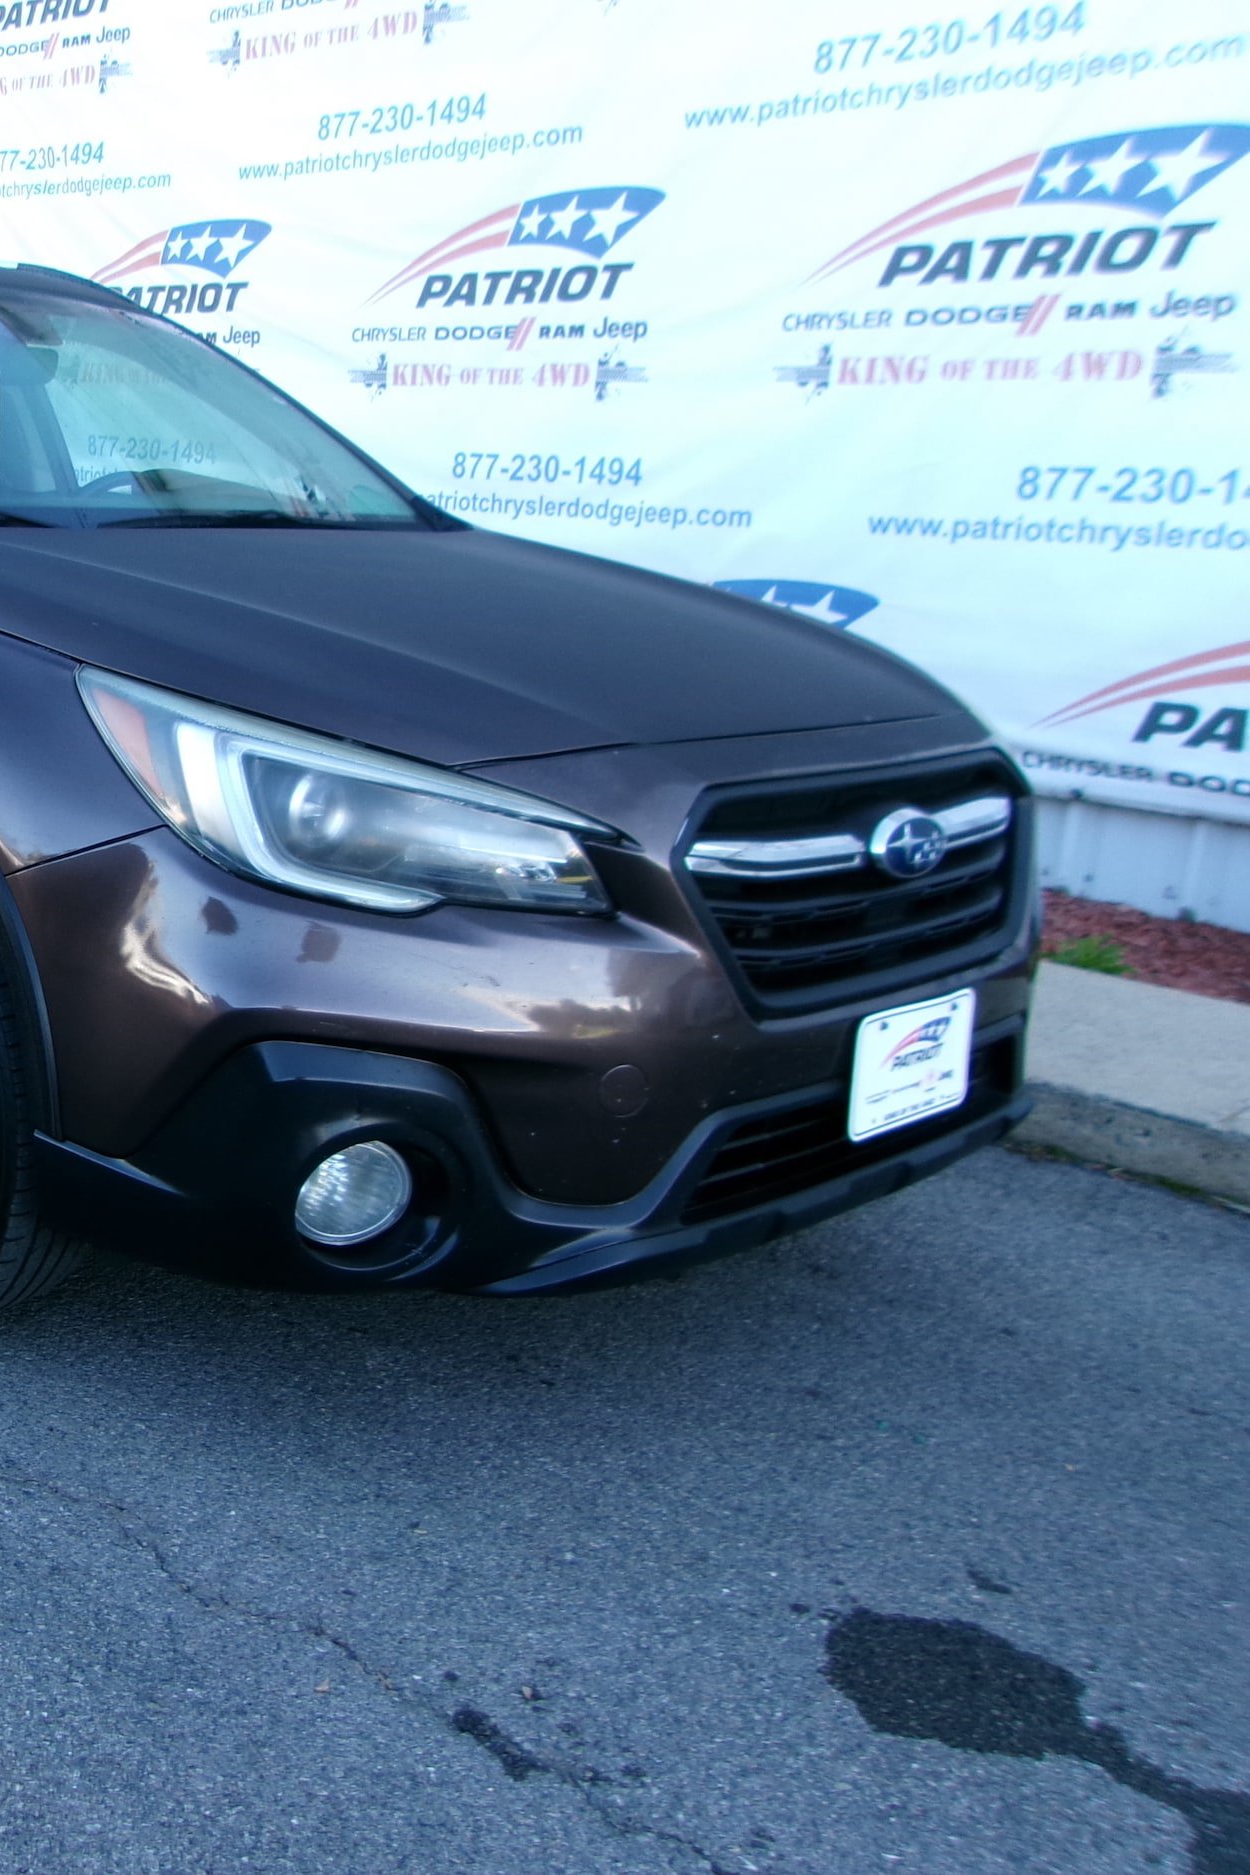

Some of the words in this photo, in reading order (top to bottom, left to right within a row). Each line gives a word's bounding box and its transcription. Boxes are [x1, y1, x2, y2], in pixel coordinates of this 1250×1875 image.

[62, 33, 92, 48] RAM
[96, 25, 132, 44] Jeep
[244, 31, 298, 61] KING
[303, 32, 324, 48] OF
[326, 24, 360, 45] THE
[367, 10, 419, 40] 4WD
[813, 0, 1087, 76] 877-230-1494
[684, 34, 1246, 131] www.patriotchryslerdodgejeep.com
[317, 92, 488, 142] 877-230-1494
[238, 124, 584, 182] www.patriotchryslerdodgejeep.com
[876, 219, 1218, 289] PATRIOT
[109, 280, 249, 316] ATRIOT
[415, 260, 636, 310] PATRIOT
[351, 325, 427, 343] CHRYSLER
[434, 323, 518, 341] DODGE
[538, 323, 586, 340] RAM
[592, 315, 648, 344] Jeep
[782, 309, 892, 334] CHRYSLER
[904, 302, 1030, 328] DODGE
[1064, 300, 1139, 322] RAM
[1150, 288, 1238, 323] Jeep
[222, 325, 261, 349] Jeep
[390, 363, 451, 388] KING
[458, 368, 481, 386] OF
[485, 367, 525, 386] THE
[531, 362, 592, 387] 4WD
[837, 355, 931, 386] KING
[939, 360, 975, 382] OF
[981, 358, 1039, 381] THE
[1053, 350, 1145, 382] 4WD
[87, 434, 217, 464] 877-230-1494
[452, 452, 644, 487] 877-230-1494
[420, 489, 754, 529] atriotchryslerdodgejeep.com
[1023, 751, 1153, 780] CHRYSLER
